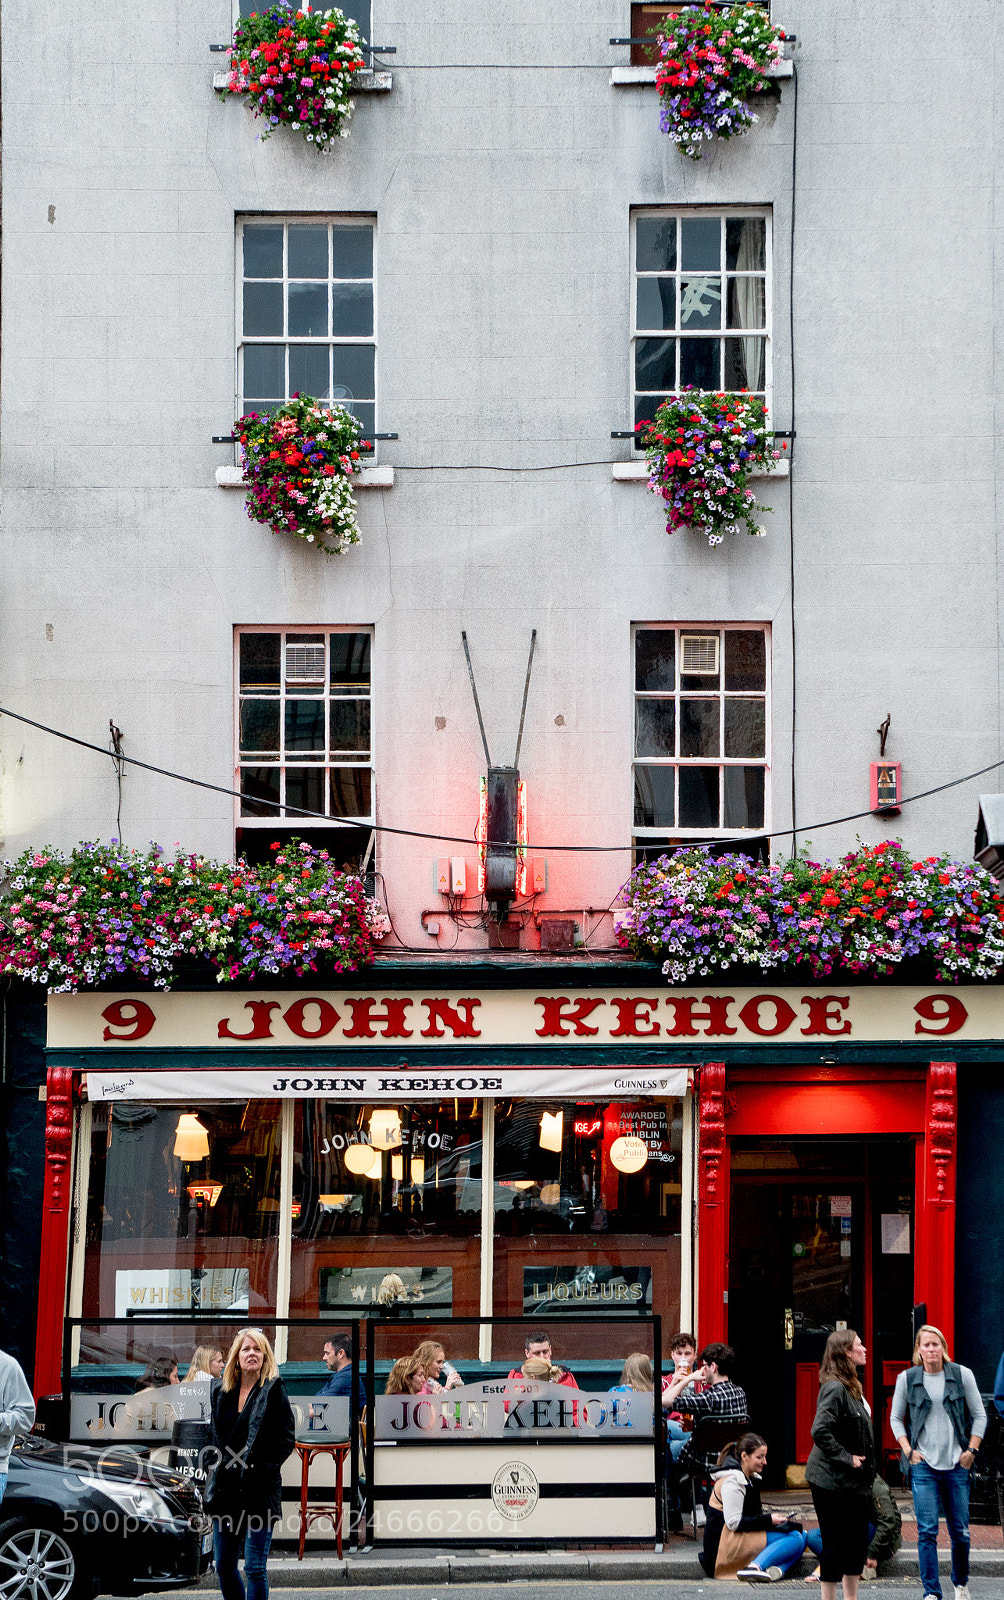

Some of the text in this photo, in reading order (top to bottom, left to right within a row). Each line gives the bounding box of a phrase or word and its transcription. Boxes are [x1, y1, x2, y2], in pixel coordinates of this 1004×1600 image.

[878, 769, 896, 783] A1
[101, 994, 969, 1041] 9 JOHN KEHOE 9
[272, 1078, 503, 1091] JOHN KEHOE
[614, 1079, 657, 1089] GUINNESS
[620, 1111, 666, 1120] AWARDED
[619, 1121, 668, 1129] Best Pub In
[320, 1128, 453, 1155] JOHN KEHOE
[626, 1131, 660, 1139] DUBLIN
[624, 1140, 662, 1150] Voted By
[623, 1149, 663, 1157] Publicans
[130, 1286, 234, 1303] WHISKIES
[533, 1282, 643, 1301] LIQUEURS
[85, 1402, 185, 1432] JOHN
[390, 1399, 635, 1431] JOHN KEHOE
[494, 1484, 537, 1495] GUINNESS
